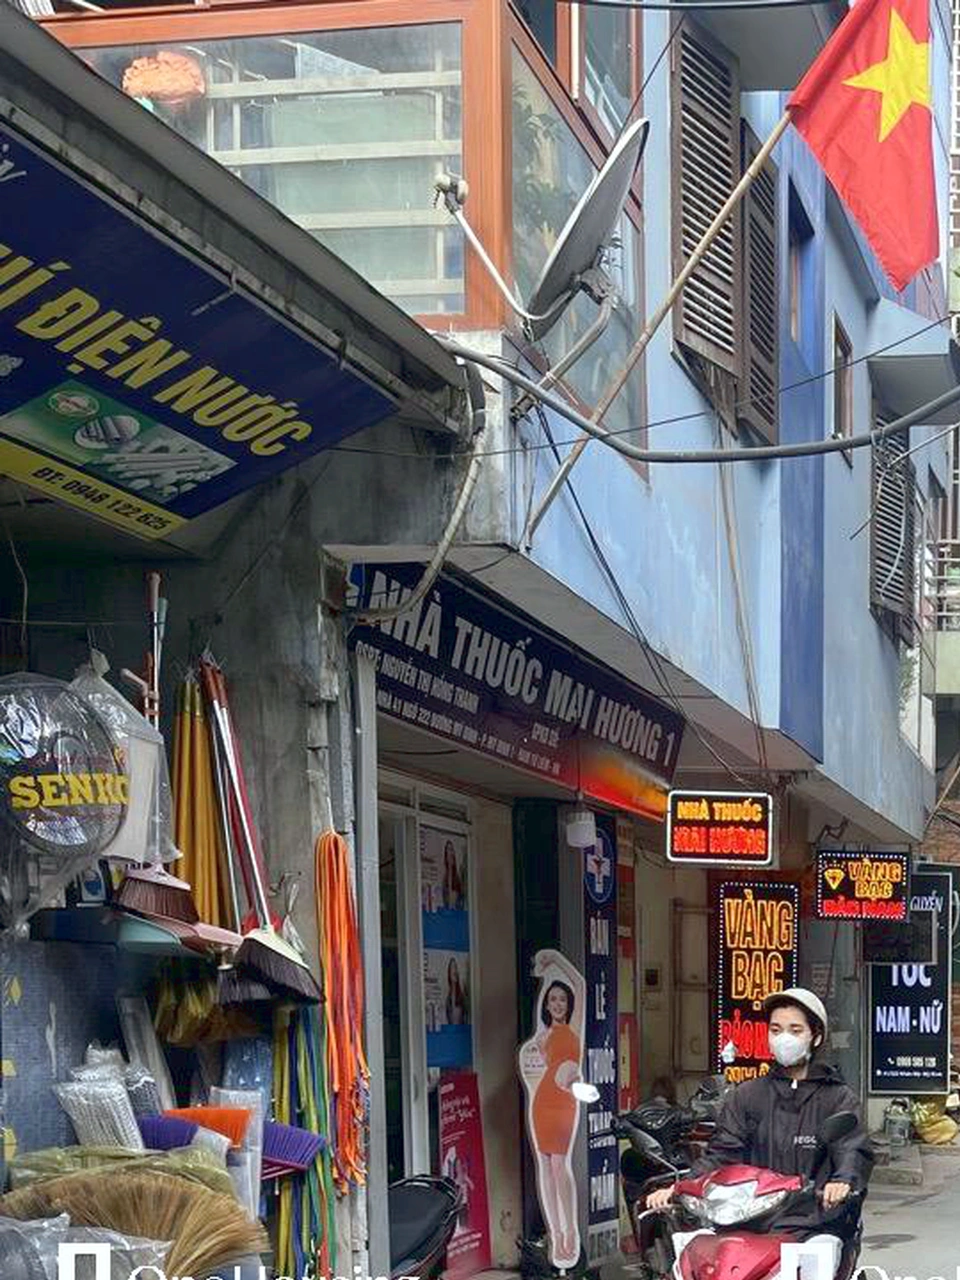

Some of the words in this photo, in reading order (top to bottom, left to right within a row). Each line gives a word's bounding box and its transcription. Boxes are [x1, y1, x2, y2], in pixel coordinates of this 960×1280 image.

[15, 287, 190, 390] ĐIỆN
[153, 365, 313, 456] NƯỚC
[369, 571, 443, 659] NHÀ
[450, 617, 544, 705] THUỐC
[543, 670, 596, 730] MAI
[593, 697, 663, 766] HƯƠNG
[677, 798, 710, 821] NHÀ
[712, 797, 763, 822] THUỐC
[848, 857, 903, 883] VÀNG
[723, 888, 794, 951] VÀNG
[731, 951, 784, 1011] BẠC
[876, 1006, 910, 1033] NAM
[919, 999, 943, 1034] NỮ
